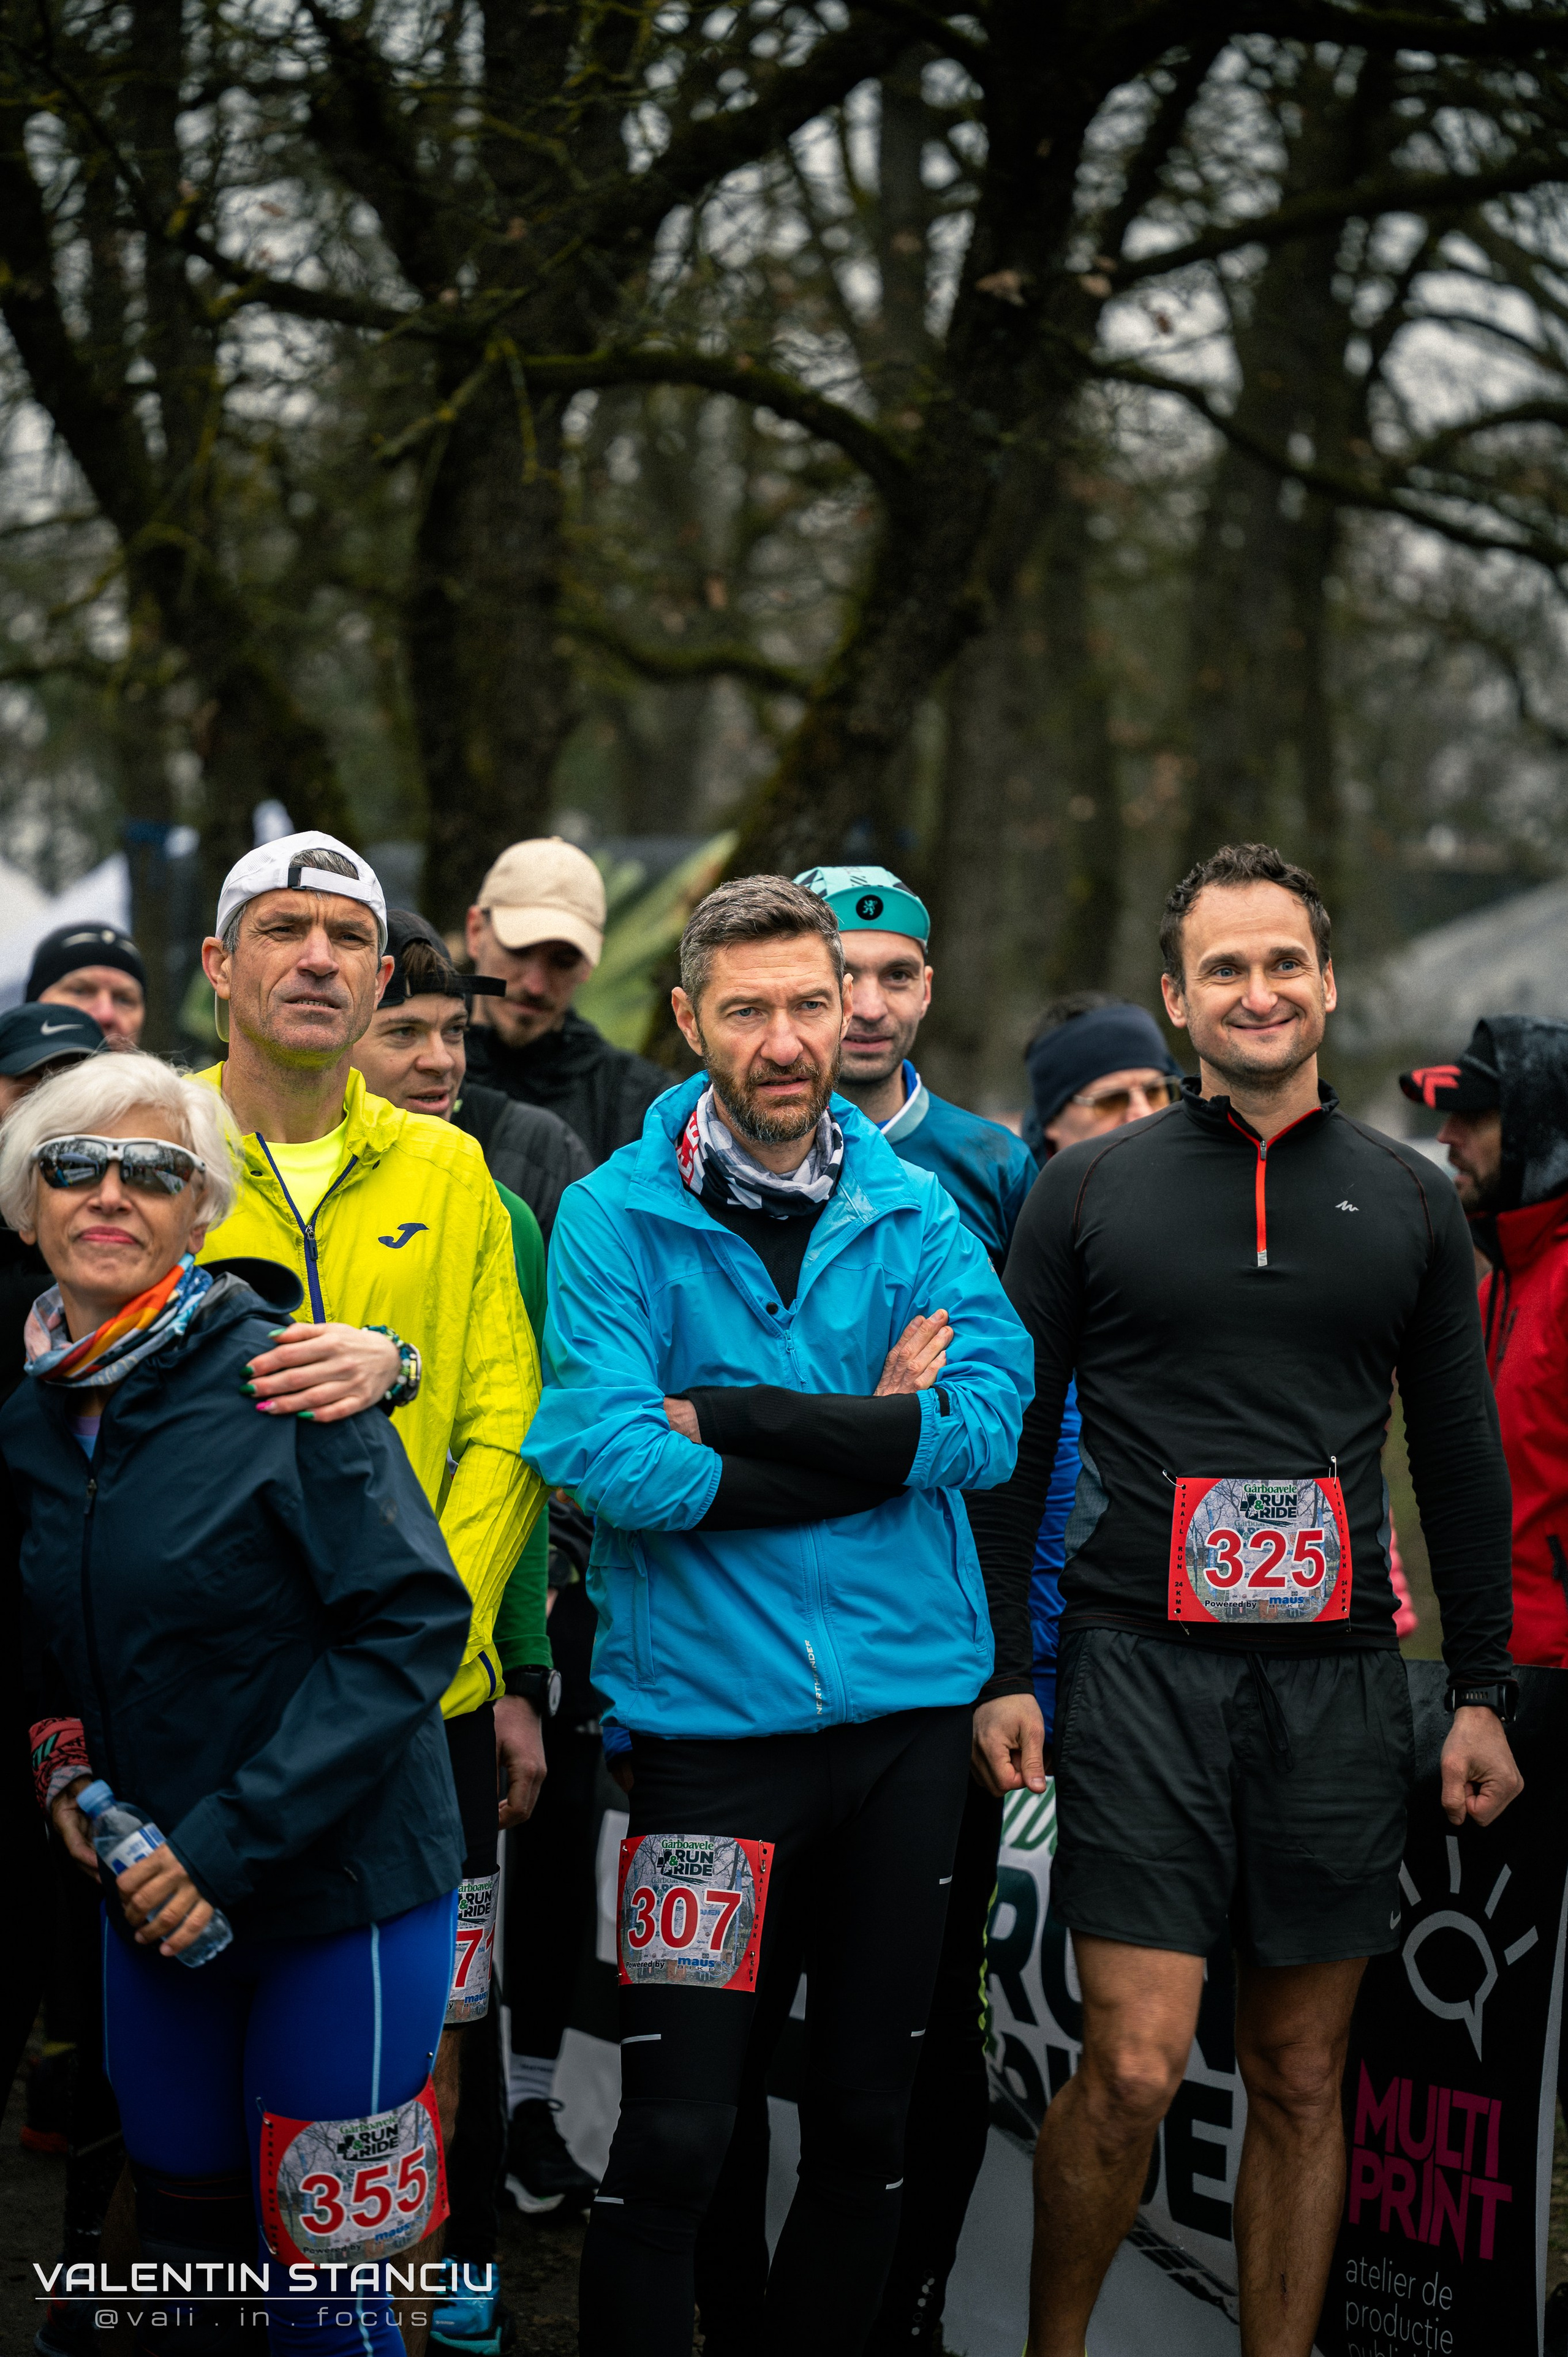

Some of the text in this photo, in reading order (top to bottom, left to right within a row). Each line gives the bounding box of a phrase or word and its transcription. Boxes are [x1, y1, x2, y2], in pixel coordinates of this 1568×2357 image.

[1244, 1484, 1297, 1493] Gârboavele
[1254, 1499, 1264, 1510] &
[1260, 1495, 1297, 1507] RUN
[1260, 1507, 1297, 1518] RIDE
[1204, 1528, 1325, 1590] 325
[1246, 1600, 1257, 1609] by
[662, 1839, 714, 1850] Gârboavele
[669, 1855, 679, 1866] &
[675, 1850, 714, 1864] RUN
[674, 1863, 713, 1877] RIDE
[458, 1880, 492, 1893] ârboavele
[459, 1899, 469, 1910] &
[466, 1890, 492, 1905] RUN
[463, 1904, 491, 1918] RIDE
[628, 1886, 742, 1953] 307
[626, 1960, 665, 1969] Powered by
[677, 1958, 715, 1967] maus
[464, 1992, 487, 2004] maus
[1354, 2057, 1502, 2179] MULTI
[359, 2124, 399, 2144] RUN
[360, 2136, 399, 2157] RIDE
[300, 2144, 428, 2236] 355
[1349, 2147, 1513, 2265] PRINT
[375, 2223, 410, 2242] maus
[303, 2244, 361, 2254] Powered by
[1346, 2257, 1453, 2310] atelier de
[1346, 2301, 1453, 2355] productie
